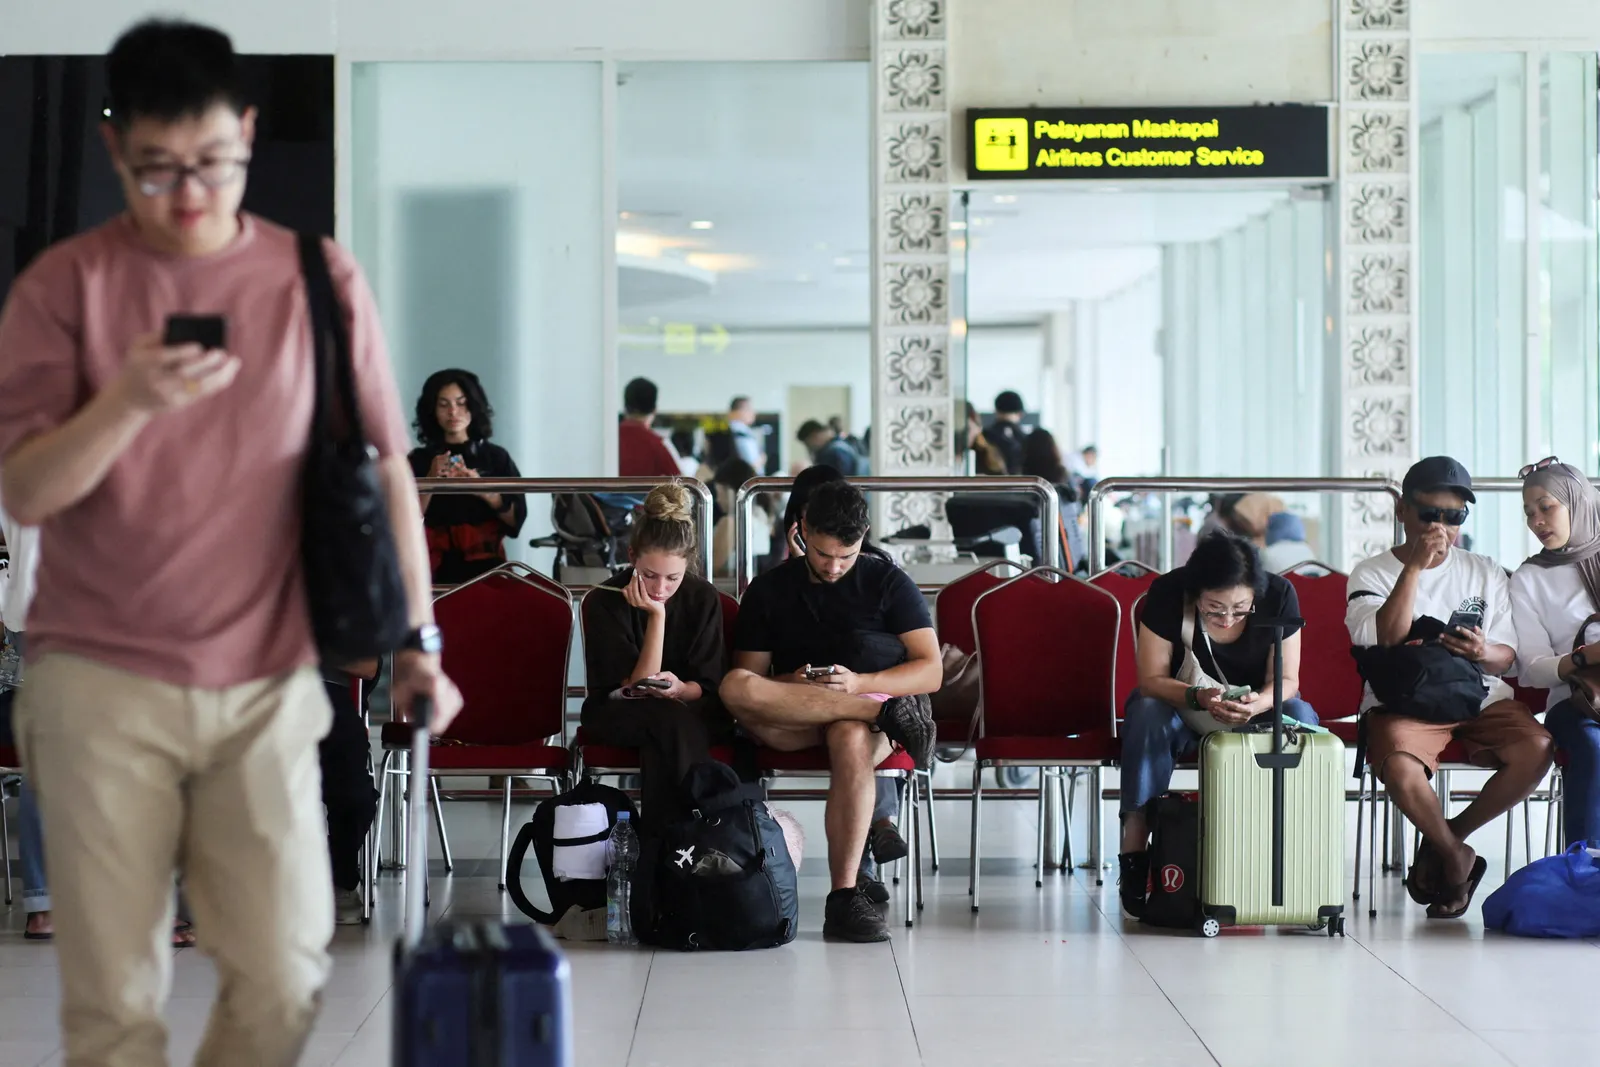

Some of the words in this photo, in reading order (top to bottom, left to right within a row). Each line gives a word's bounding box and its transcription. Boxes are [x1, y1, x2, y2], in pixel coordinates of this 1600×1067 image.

[1033, 120, 1130, 143] Pelayanan
[1131, 118, 1219, 142] Maskapai
[1035, 148, 1103, 167] Airlines
[1105, 147, 1195, 167] Customer
[1195, 146, 1265, 167] Service
